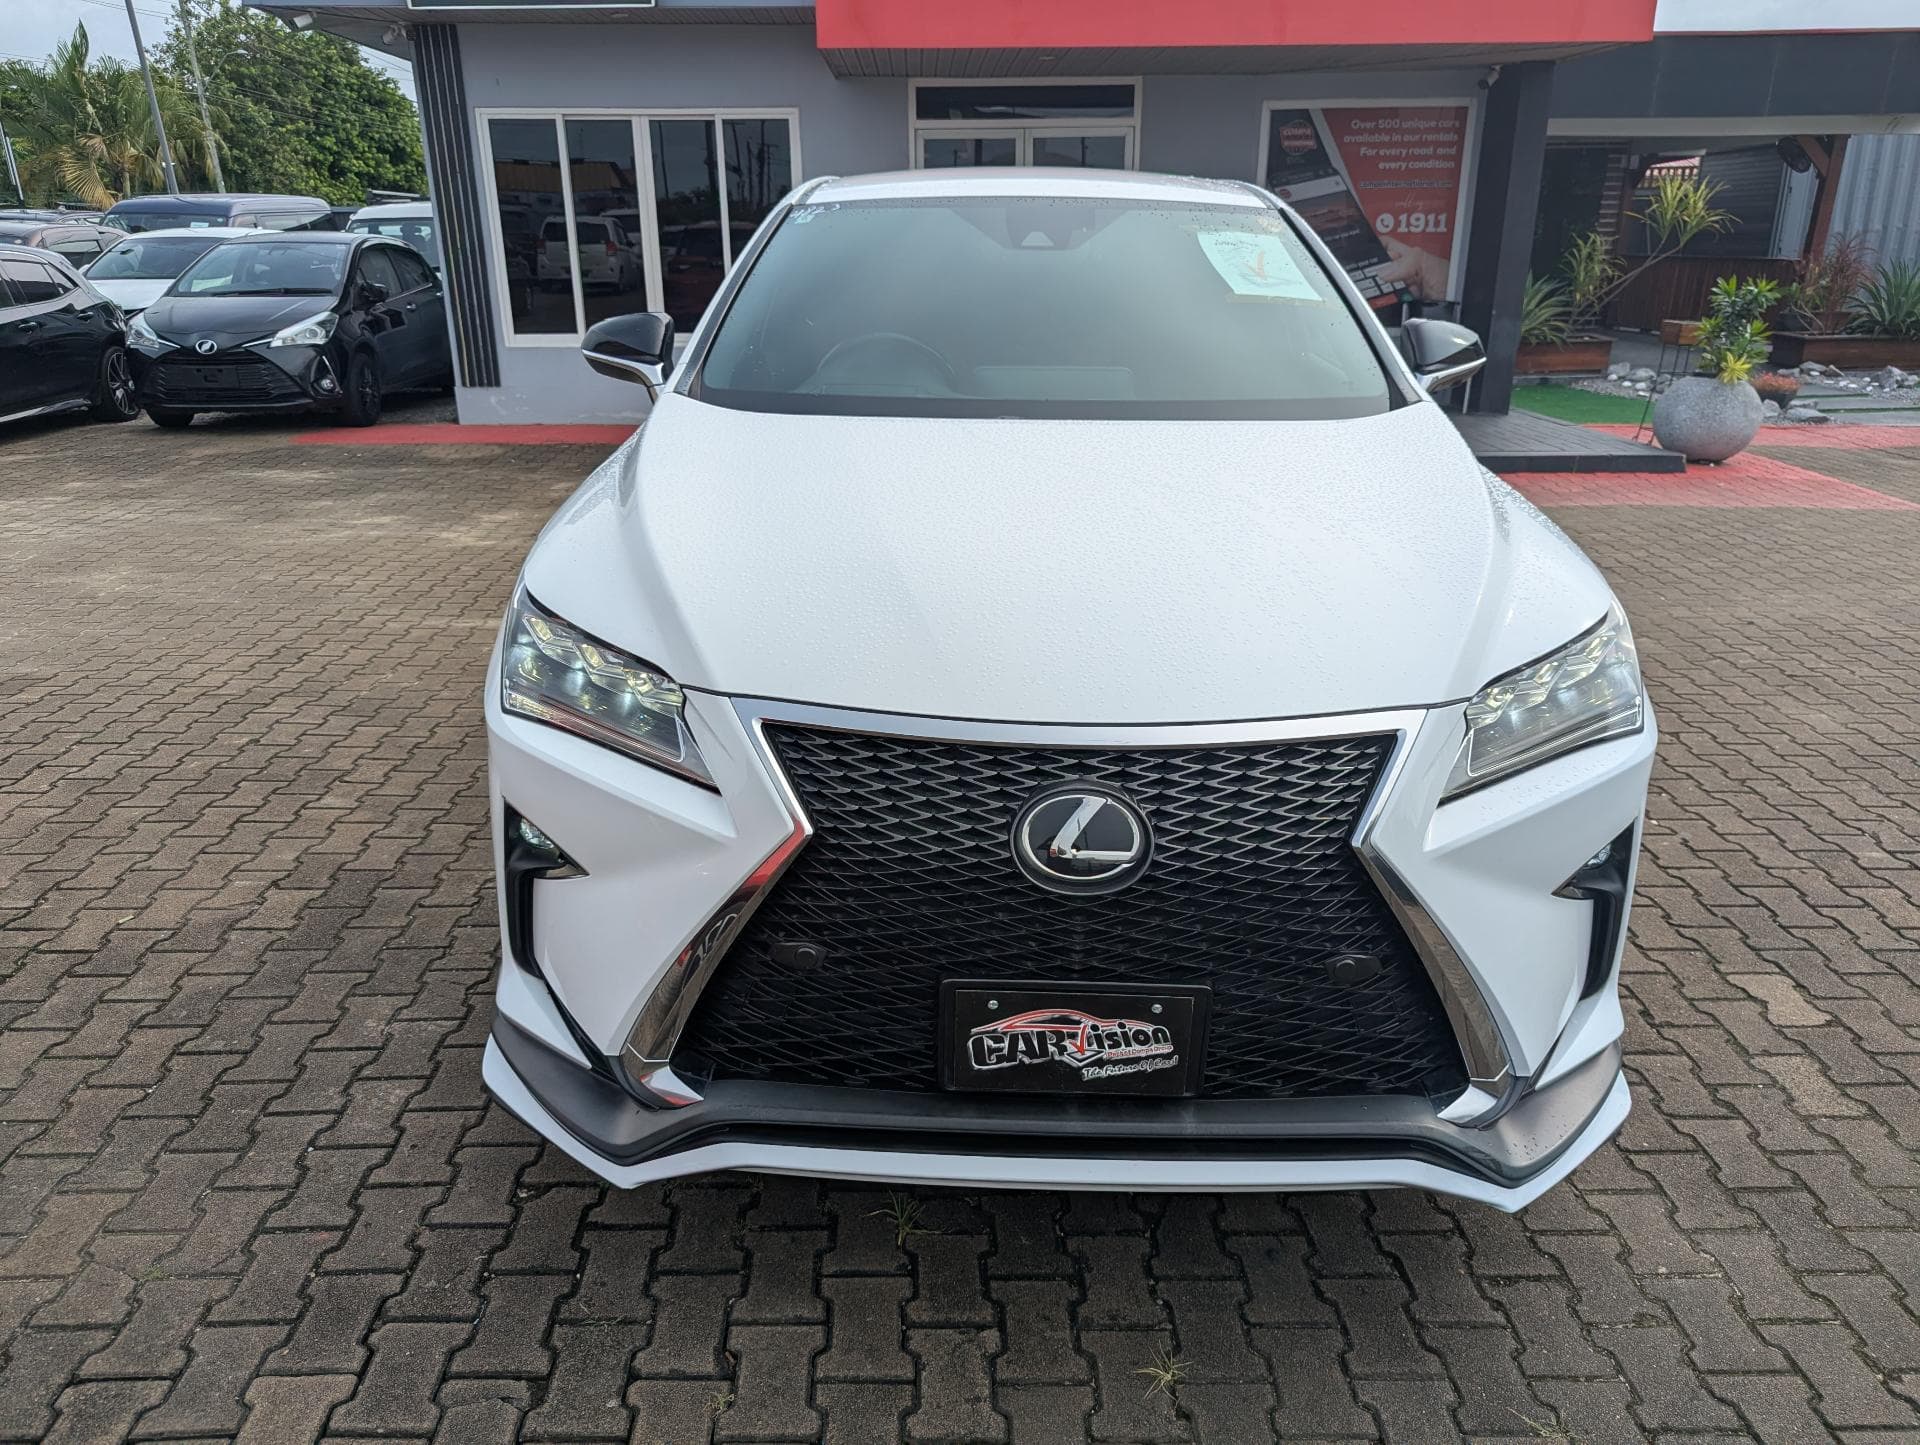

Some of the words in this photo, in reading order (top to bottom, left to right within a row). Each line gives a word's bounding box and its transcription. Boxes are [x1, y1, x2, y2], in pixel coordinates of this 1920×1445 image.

[1350, 119, 1377, 129] Over
[1378, 119, 1400, 128] 500
[1401, 118, 1437, 130] unique
[1438, 119, 1460, 128] cars
[1343, 132, 1391, 143] available
[1391, 132, 1402, 142] in
[1403, 134, 1421, 142] our
[1422, 132, 1459, 142] rentals
[1360, 146, 1379, 157] For
[1379, 147, 1408, 159] every
[1408, 146, 1433, 155] road
[1436, 145, 1457, 155] and
[1378, 161, 1408, 171] every
[1408, 159, 1455, 169] condition
[1396, 212, 1448, 233] 1911
[1083, 1067, 1103, 1079] The
